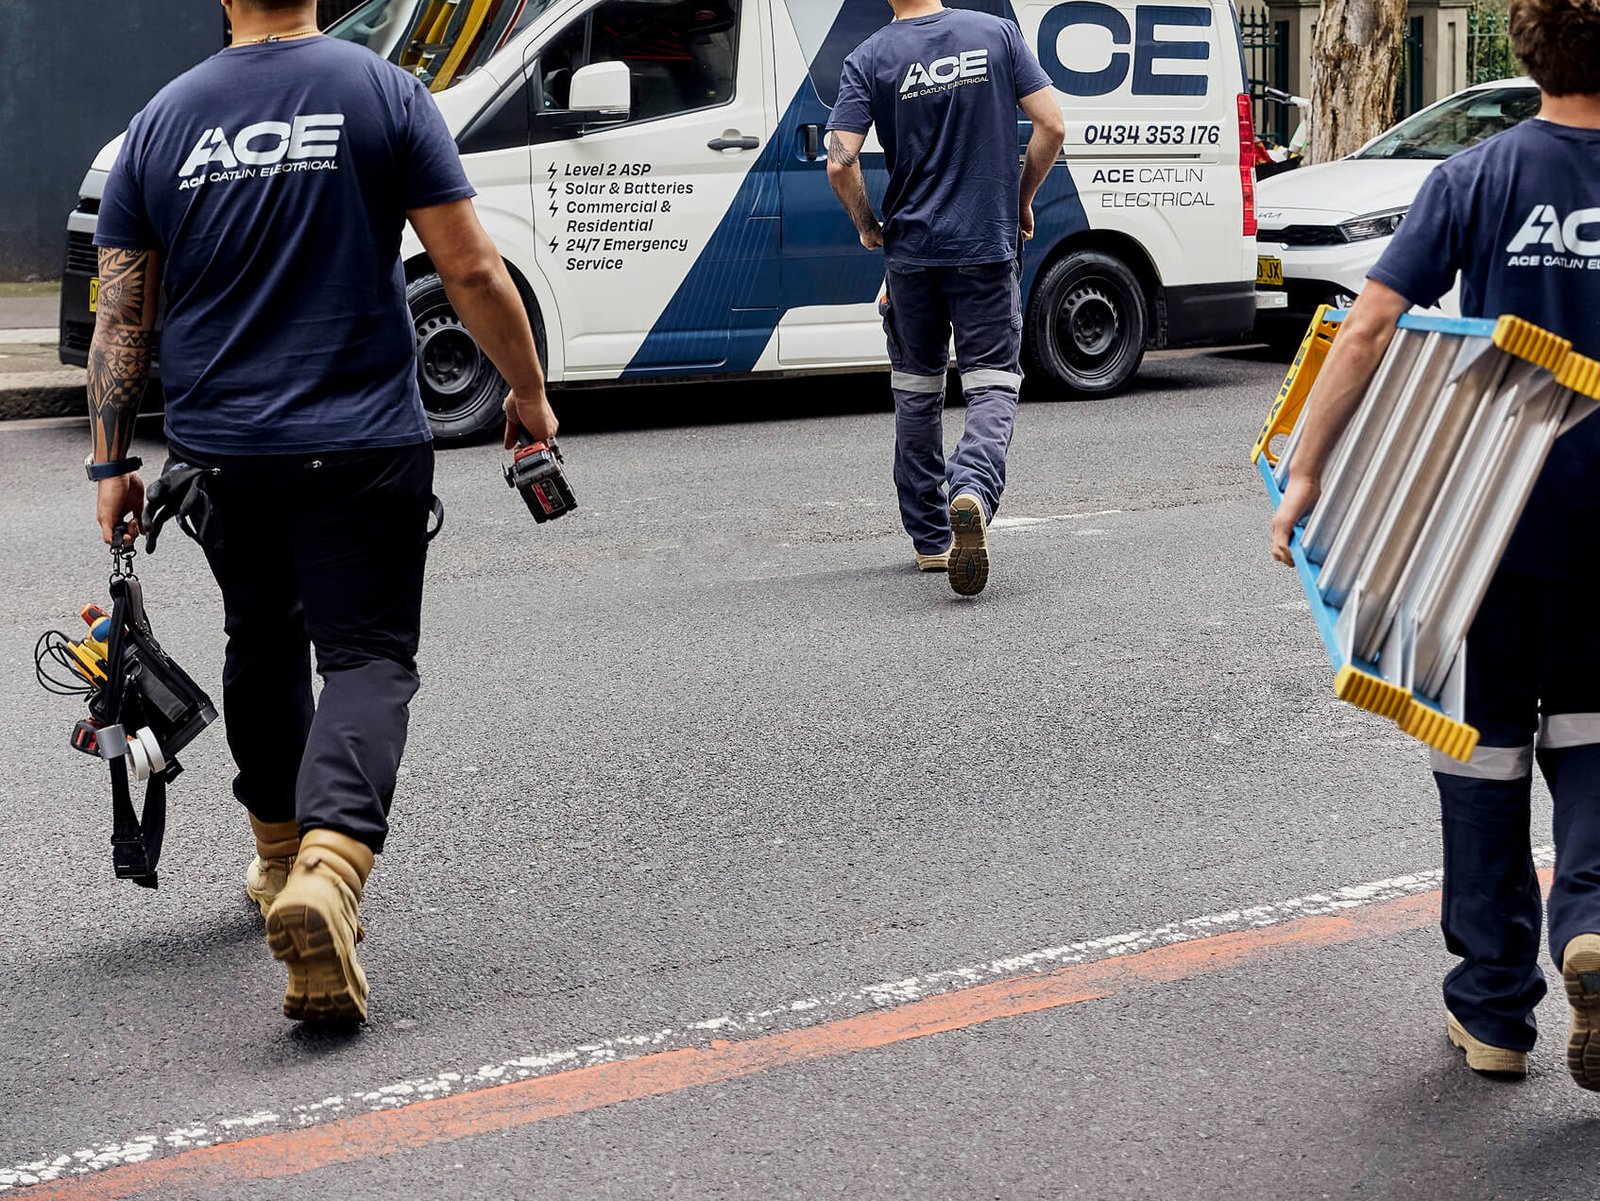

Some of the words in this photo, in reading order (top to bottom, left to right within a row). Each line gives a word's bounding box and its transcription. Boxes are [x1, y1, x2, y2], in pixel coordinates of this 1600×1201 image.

[899, 49, 988, 93] ACE
[902, 92, 919, 100] ACE
[920, 85, 946, 96] CATLIN
[947, 76, 989, 90] ELECTRICAL
[1084, 125, 1140, 145] 0434
[1145, 126, 1186, 145] 353
[1190, 125, 1221, 145] 176
[178, 114, 345, 177] ACE
[179, 174, 206, 191] ACE
[209, 169, 256, 183] CATLIN
[260, 160, 338, 178] ELECTRICAL
[565, 163, 604, 176] Level
[606, 163, 617, 176] 2
[619, 163, 652, 176] ASP
[1092, 170, 1135, 184] ACE
[1139, 168, 1203, 184] CATLIN
[565, 182, 606, 195] Solar
[608, 182, 620, 195] &
[624, 181, 694, 195] Batteries
[566, 200, 658, 214] Commercial
[660, 200, 672, 213] &
[1101, 192, 1216, 208] ELECTRICAL
[566, 218, 654, 233] Residential
[566, 238, 601, 253] 24/7
[603, 238, 689, 253] Emergency
[566, 257, 624, 271] Service
[1507, 255, 1540, 267] ACE
[1543, 255, 1584, 270] CATLIN
